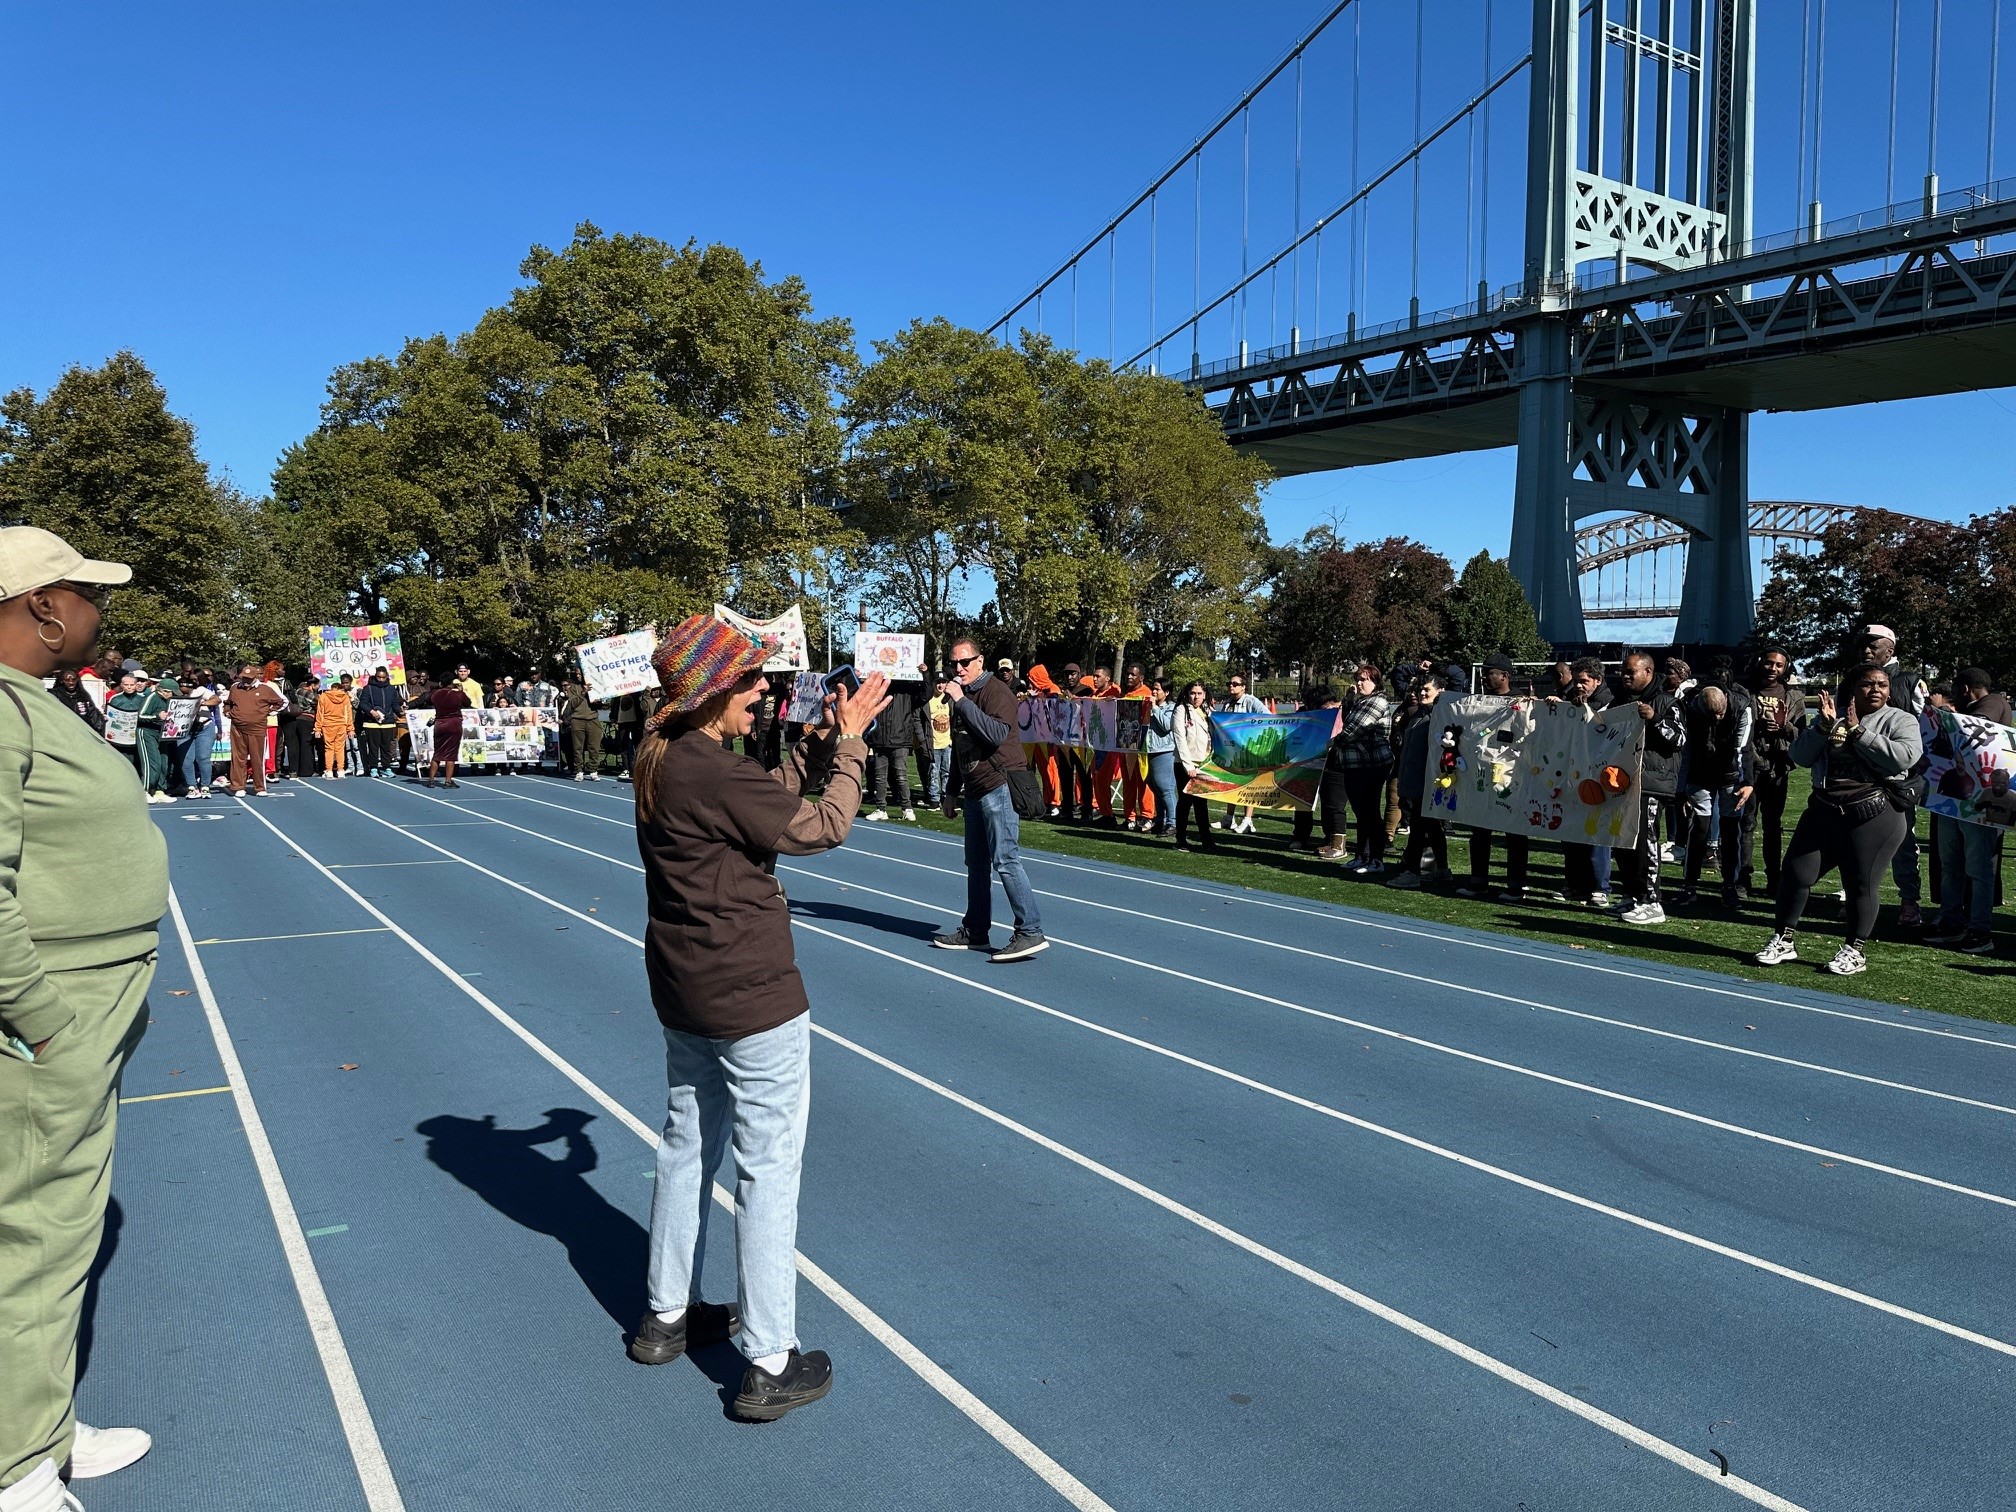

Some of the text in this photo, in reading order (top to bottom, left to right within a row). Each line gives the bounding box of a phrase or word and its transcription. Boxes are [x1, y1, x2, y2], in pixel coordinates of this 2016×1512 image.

[319, 636, 392, 649] VALENTINE
[608, 639, 628, 649] 2024
[332, 651, 341, 662] 4
[370, 649, 379, 660] 5
[582, 646, 597, 657] WE
[595, 654, 647, 673] TOGETHER
[615, 680, 642, 691] VERNON
